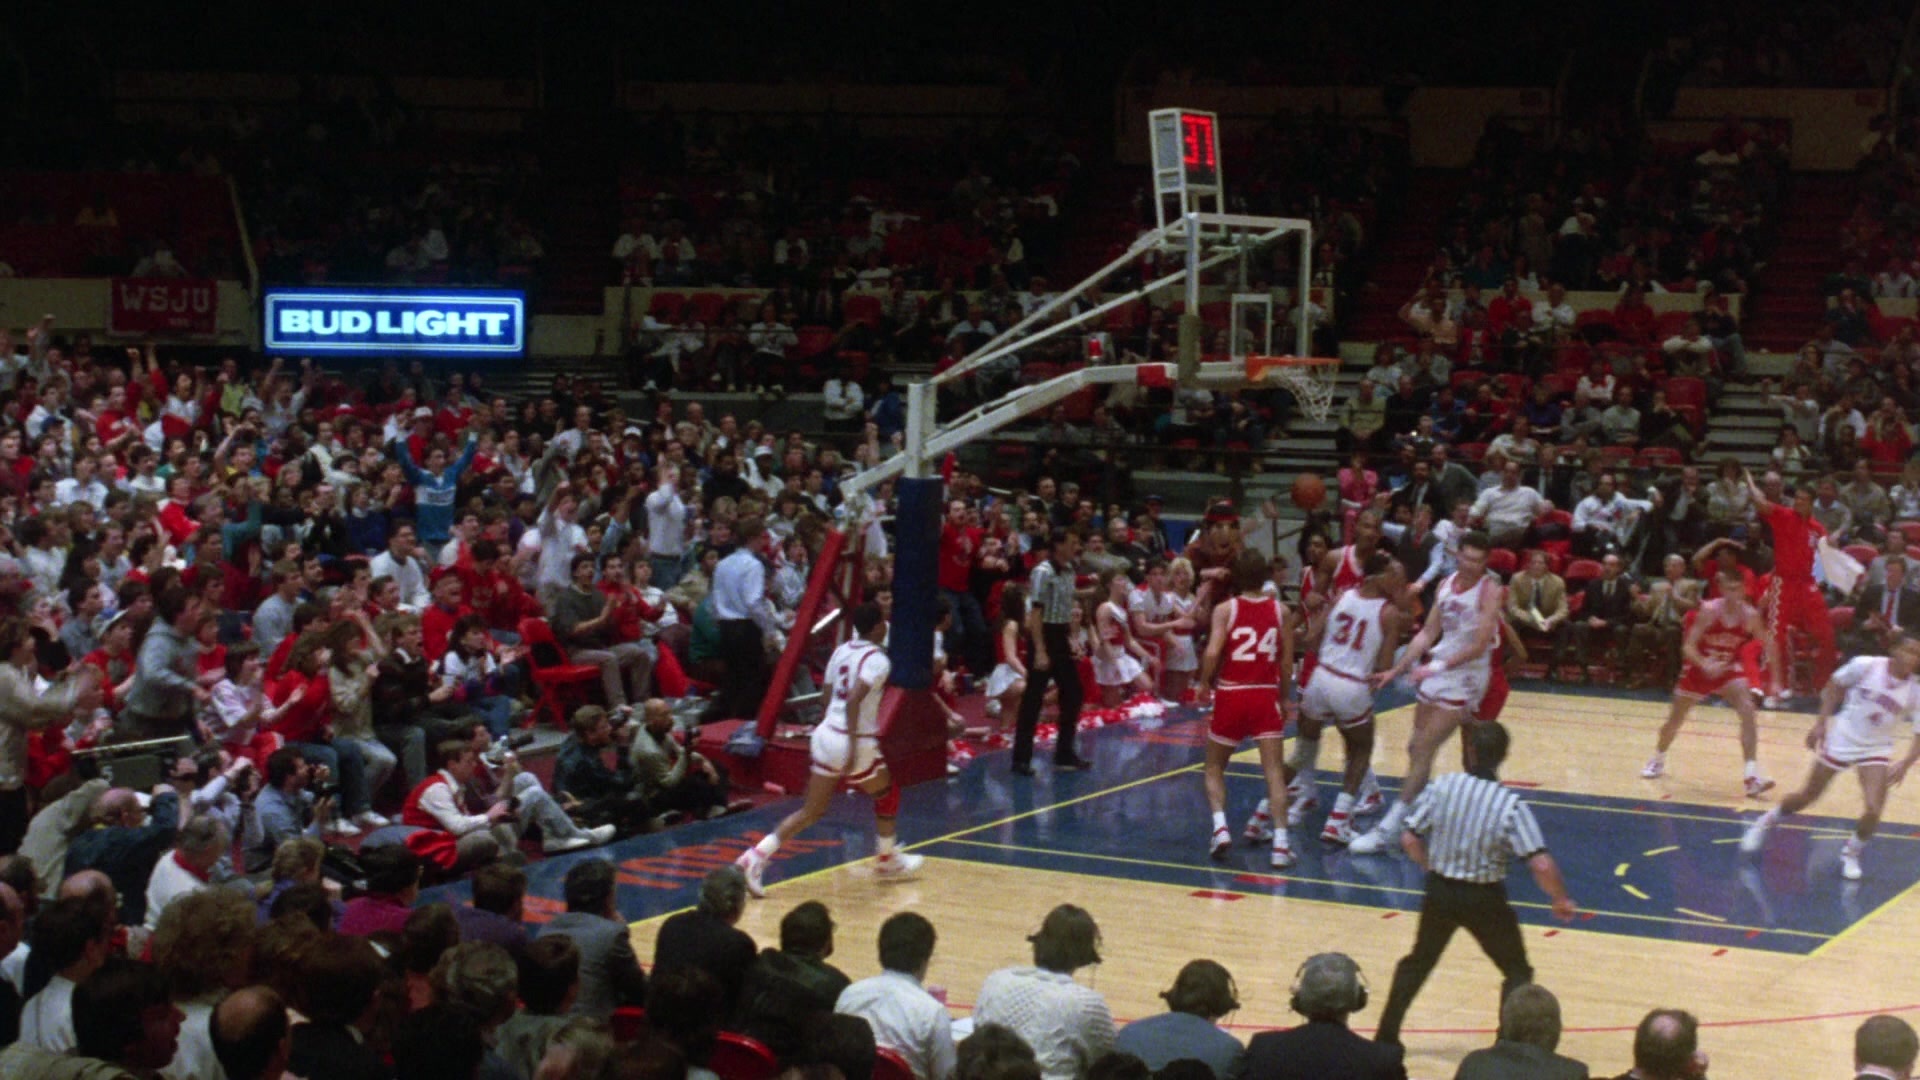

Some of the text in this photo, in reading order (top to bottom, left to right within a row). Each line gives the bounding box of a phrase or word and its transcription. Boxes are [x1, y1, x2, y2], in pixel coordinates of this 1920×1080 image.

[121, 283, 209, 313] WSJU
[280, 309, 510, 336] BUD LIGHT
[1231, 626, 1278, 662] 24
[1332, 611, 1368, 651] 31
